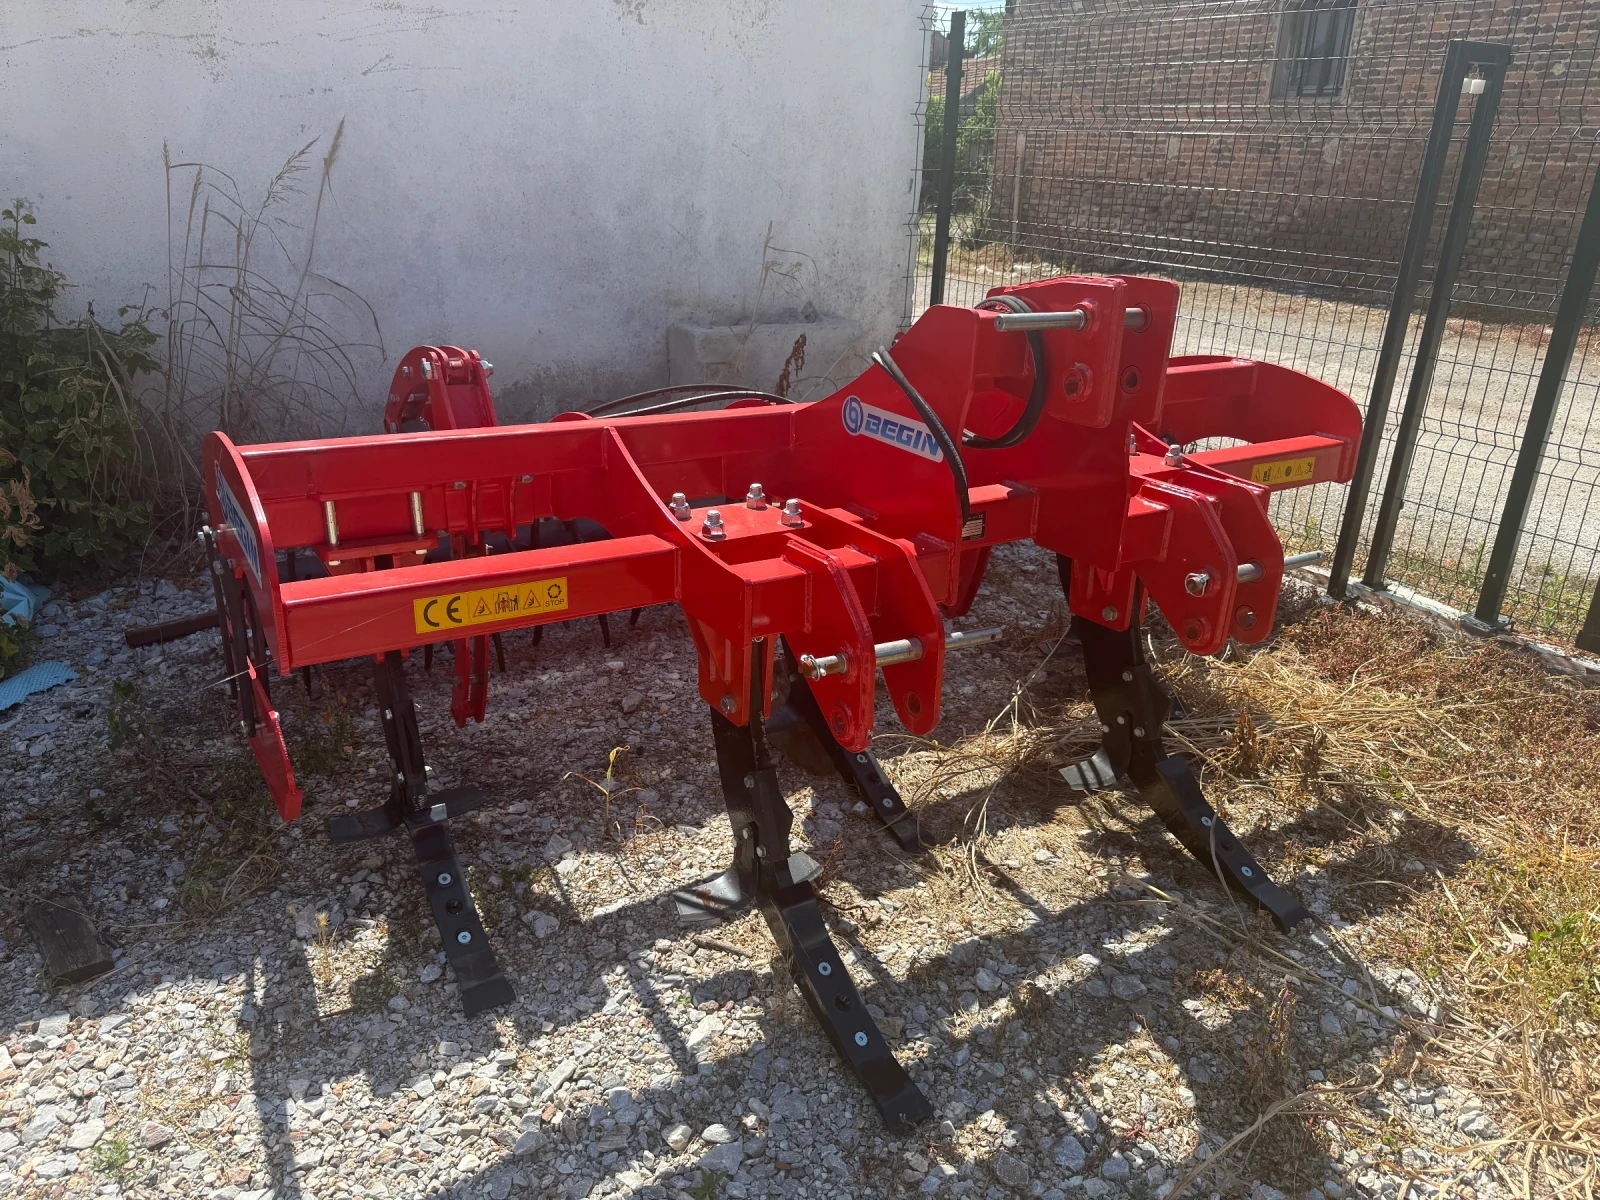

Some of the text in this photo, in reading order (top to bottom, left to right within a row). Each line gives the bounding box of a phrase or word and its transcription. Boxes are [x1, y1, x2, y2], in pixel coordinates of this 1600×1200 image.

[864, 413, 941, 456] BEGIN
[423, 595, 462, 627] CE
[545, 598, 565, 607] STOP
